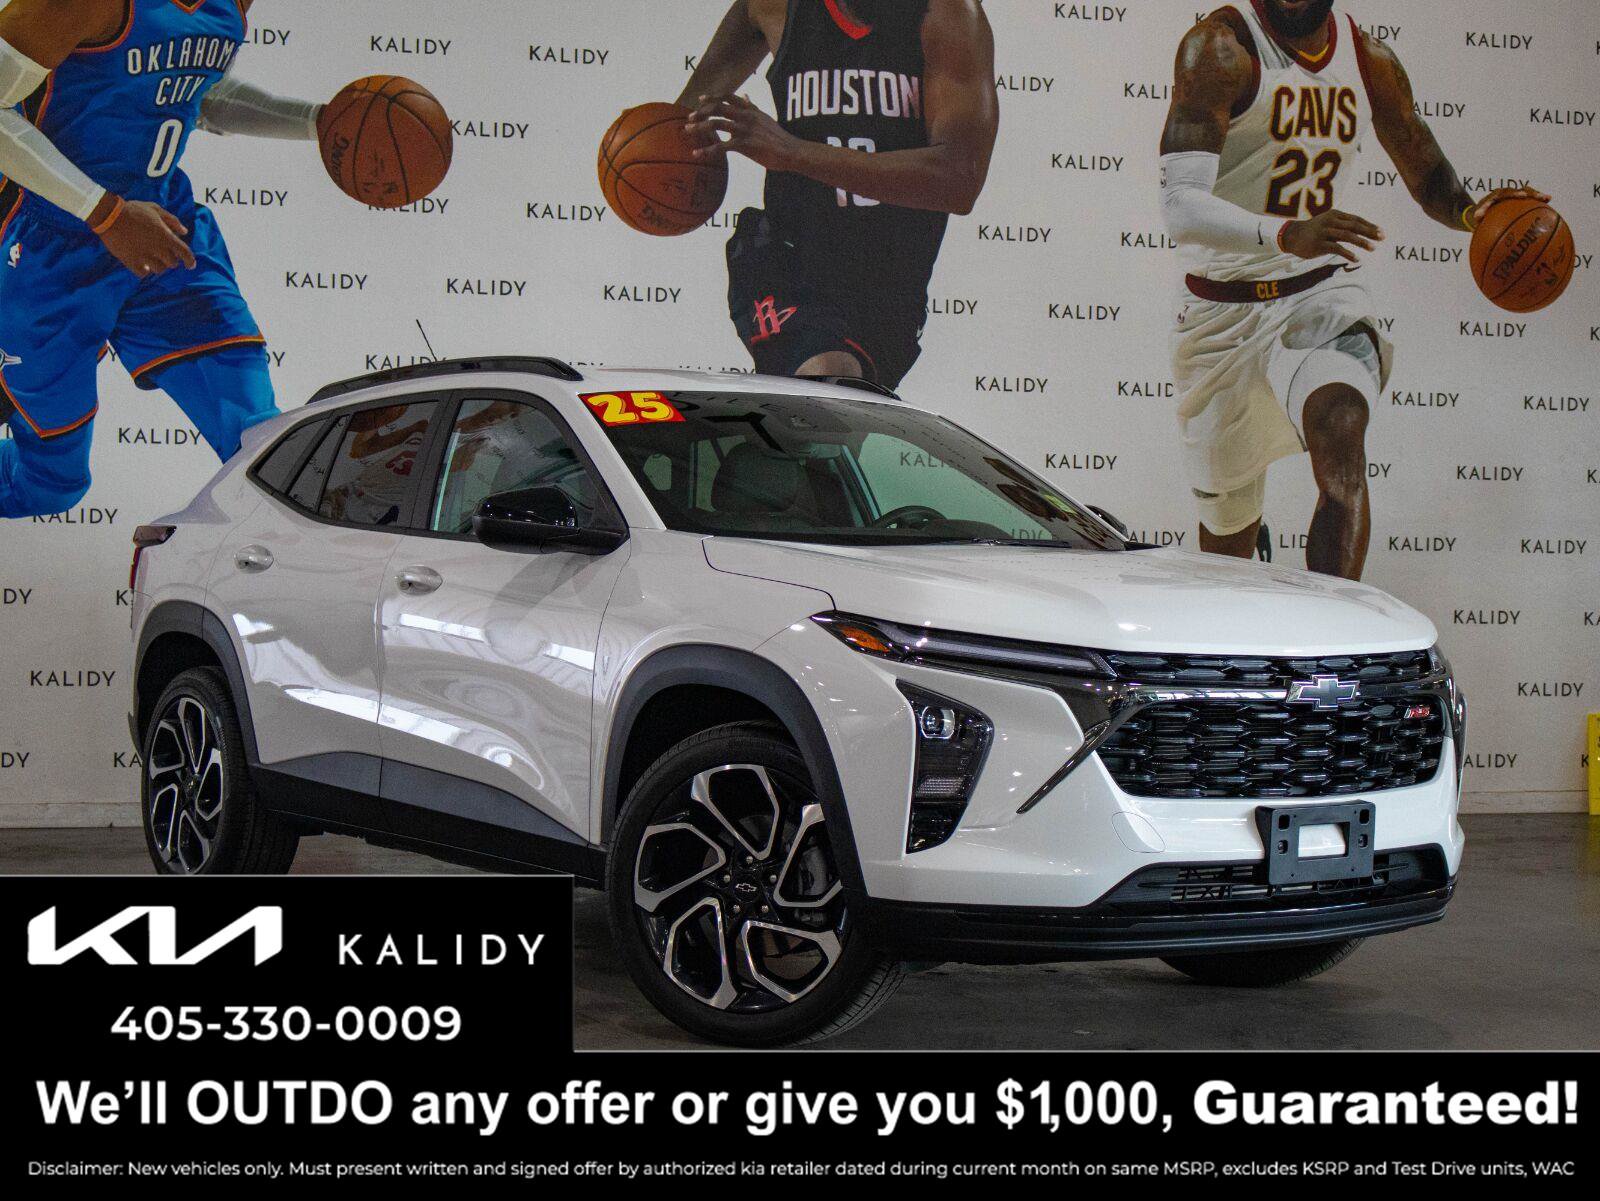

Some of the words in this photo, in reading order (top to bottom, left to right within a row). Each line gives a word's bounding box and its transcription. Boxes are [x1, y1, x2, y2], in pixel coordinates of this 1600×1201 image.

[1055, 3, 1126, 23] KALIDY
[242, 28, 291, 45] IDY
[371, 35, 451, 56] KALIDY
[1466, 32, 1532, 50] KALIDY
[127, 37, 236, 75] OKLAHOM
[529, 45, 609, 66] KALIDY
[155, 76, 206, 106] CITY
[995, 75, 1054, 93] ALIDY
[1124, 83, 1175, 100] KALI
[786, 68, 921, 122] HOUSTON
[1270, 84, 1357, 144] CAVS
[1414, 101, 1465, 118] ALIDY
[1531, 108, 1596, 126] KALIDY
[146, 118, 183, 178] 0
[1052, 153, 1124, 172] KALIDY
[1264, 147, 1342, 218] 23
[1358, 172, 1398, 187] IDY
[205, 188, 288, 207] KALIDY
[527, 203, 606, 222] KALIDY
[978, 225, 1051, 243] KALIDY
[1395, 246, 1463, 263] KALIDY
[286, 272, 367, 290] KALIDY
[447, 279, 526, 296] KALIDY
[1256, 281, 1280, 299] CLE
[604, 285, 681, 303] KALIDY
[926, 298, 978, 315] LIDY
[1049, 304, 1120, 322] KALIDY
[1459, 321, 1526, 338] KALIDY
[976, 376, 1048, 393] KALIDY
[1118, 381, 1174, 397] KALID
[587, 392, 674, 423] 25
[1392, 391, 1459, 408] KALIDY
[1523, 395, 1590, 412] KALIDY
[118, 427, 201, 445] KALIDY
[1046, 454, 1117, 470] KALIDY
[1457, 466, 1523, 481] KALIDY
[1129, 531, 1186, 546] ALIDY
[1389, 537, 1457, 552] KALIDY
[1521, 539, 1587, 555] KALIDY
[1453, 610, 1520, 625] KALIDY
[30, 671, 116, 687] KALIDY
[1518, 682, 1584, 697] KALIDY
[1463, 754, 1518, 769] ALIDY
